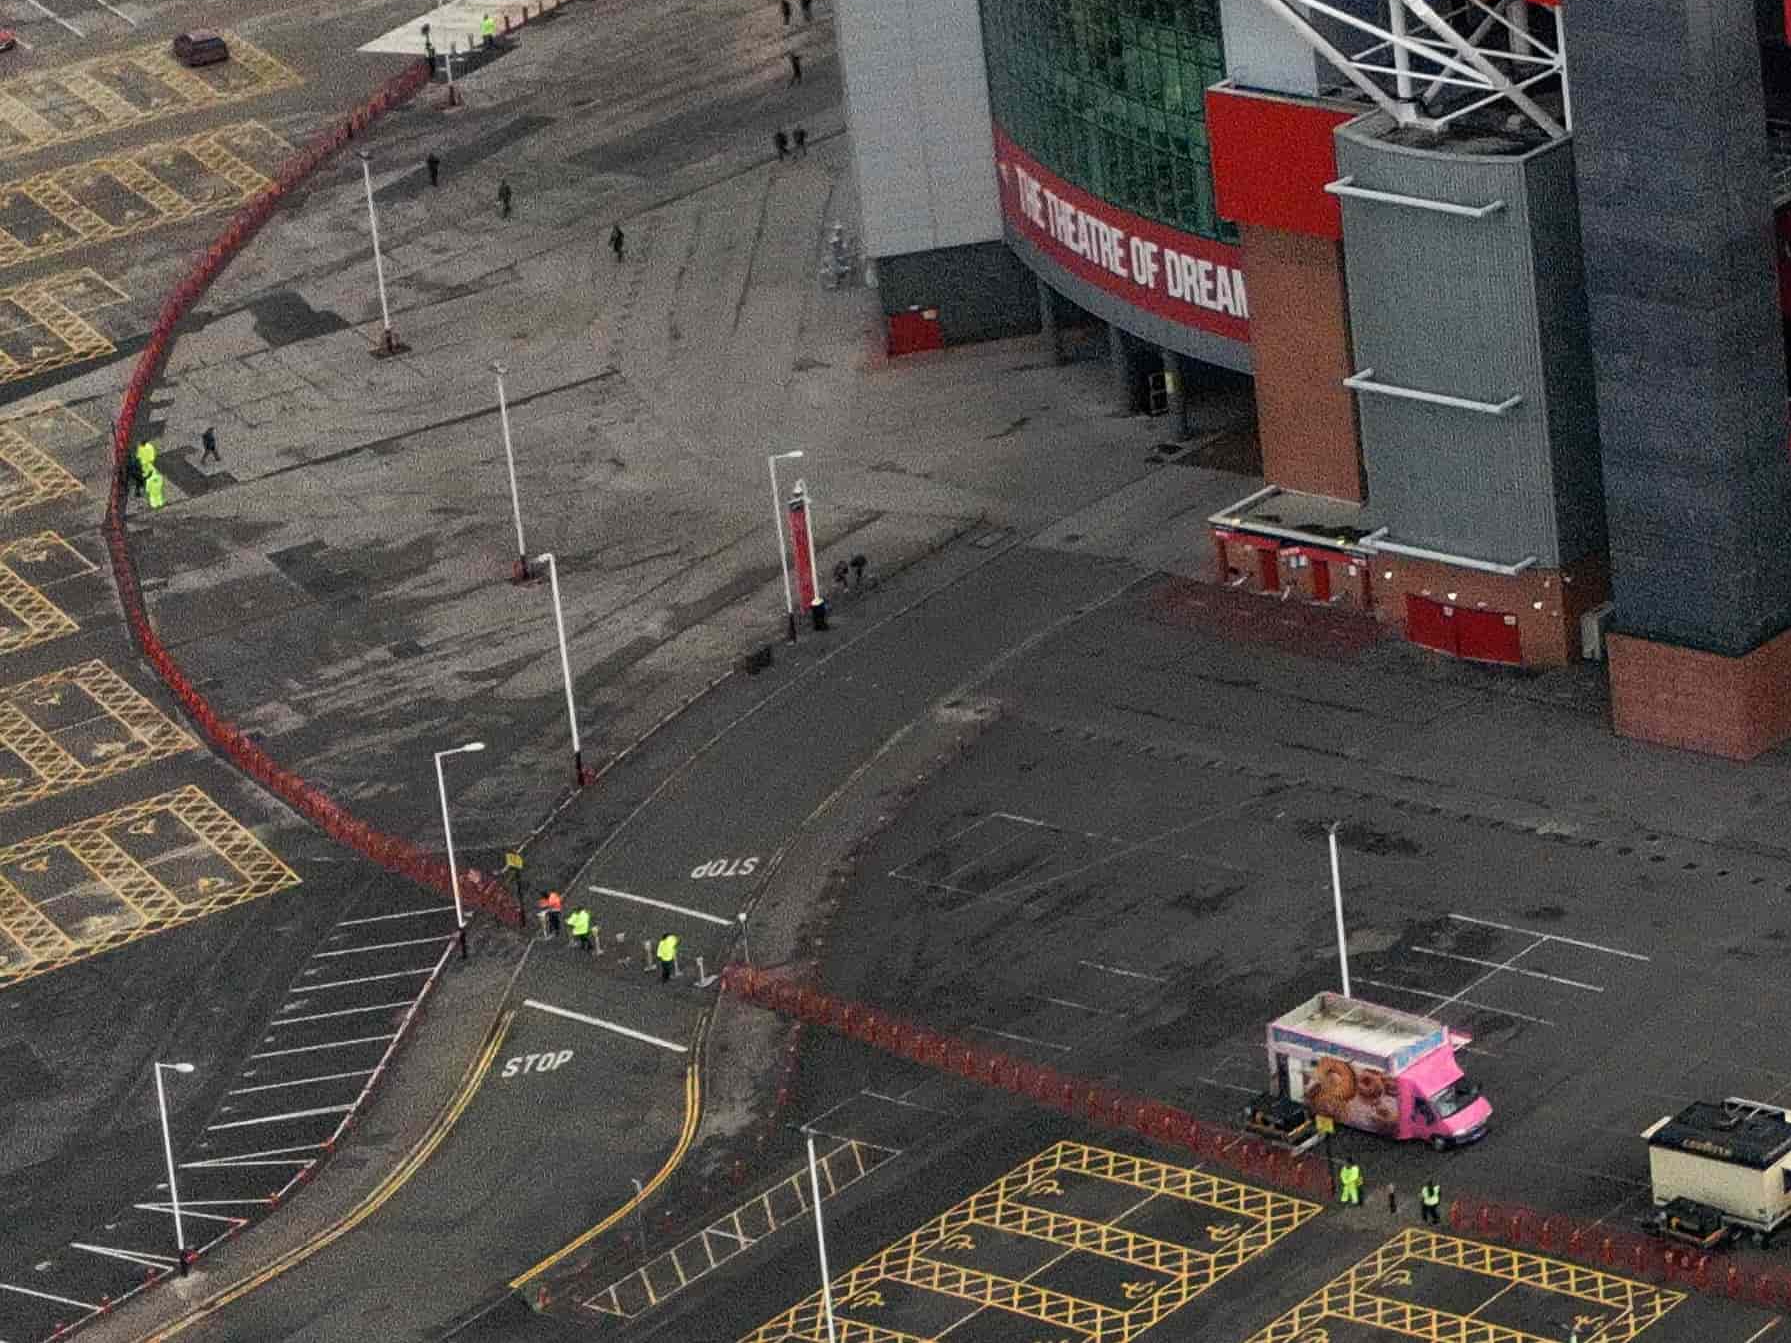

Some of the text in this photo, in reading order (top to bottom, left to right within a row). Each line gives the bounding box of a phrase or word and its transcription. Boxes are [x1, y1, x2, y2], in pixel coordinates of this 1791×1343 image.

[1015, 166, 1045, 231] THE
[1043, 188, 1129, 278] THEATRE
[1129, 236, 1158, 289] OF
[691, 857, 759, 879] STOP
[501, 1050, 574, 1078] STOP
